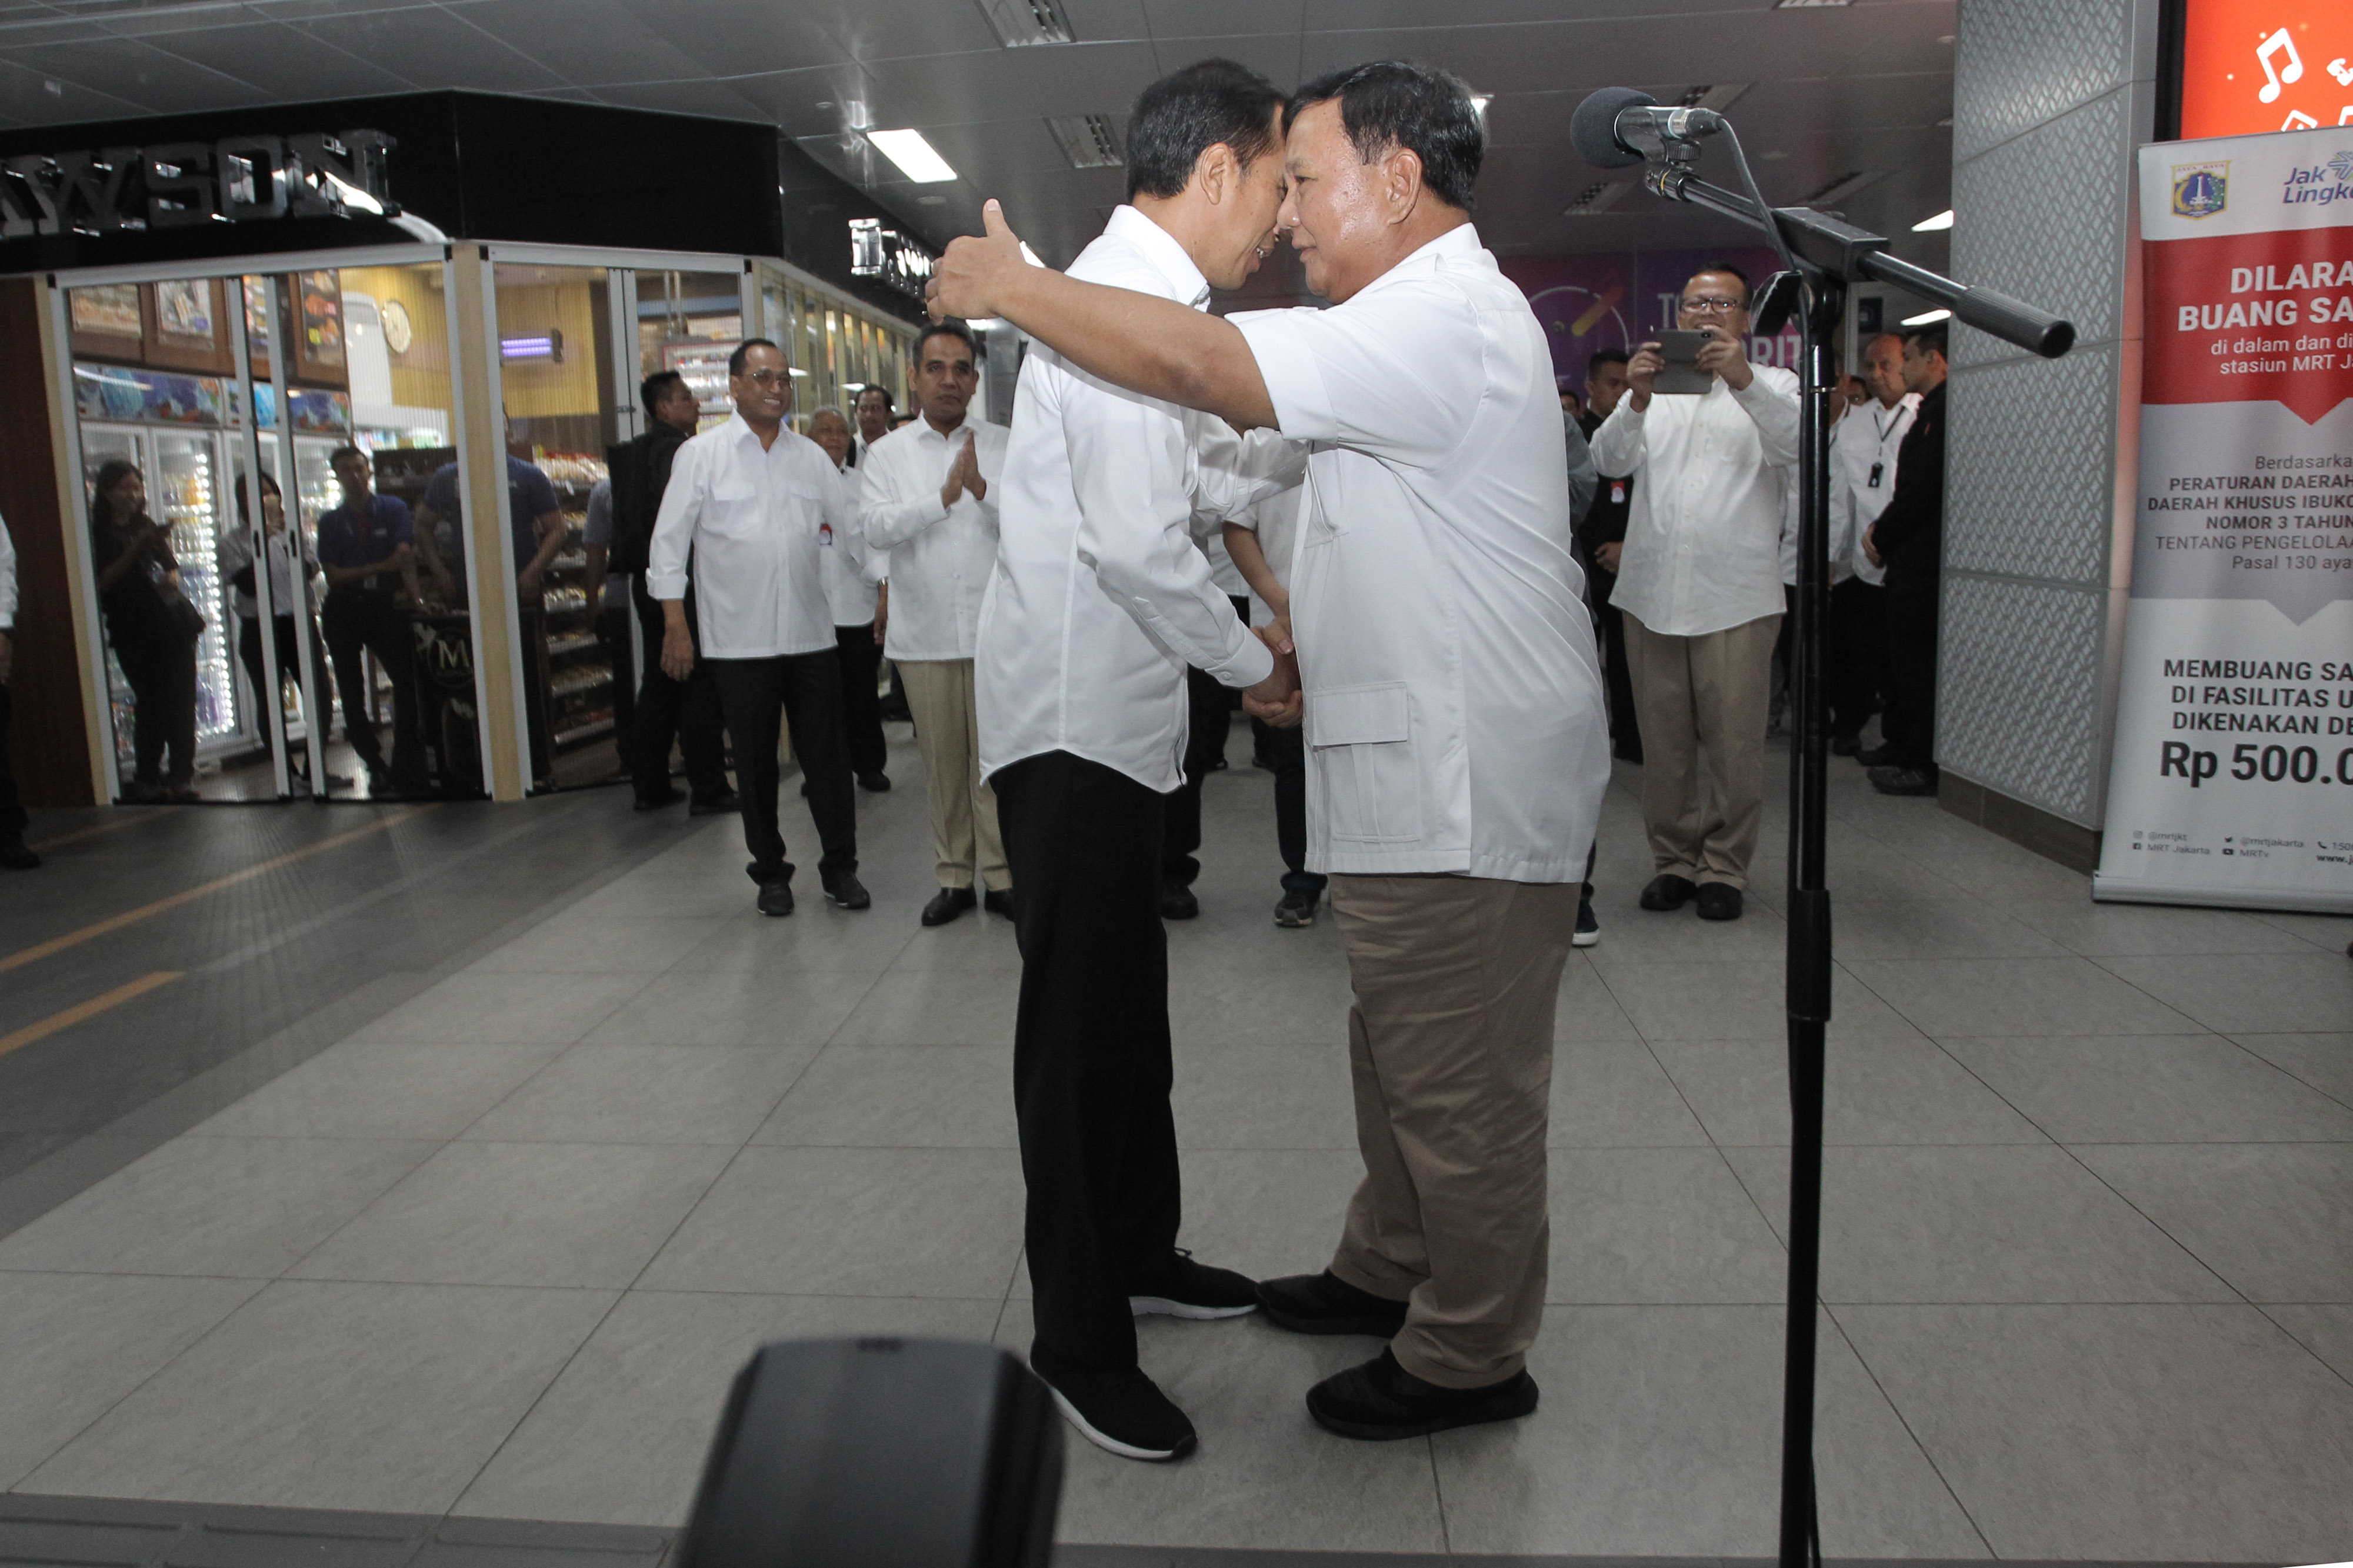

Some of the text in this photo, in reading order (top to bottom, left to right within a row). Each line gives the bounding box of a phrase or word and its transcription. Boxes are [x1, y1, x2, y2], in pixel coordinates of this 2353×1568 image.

[2283, 166, 2327, 185] Jak
[2282, 182, 2353, 206] Lingk
[2231, 261, 2353, 293] DILARA
[2178, 296, 2353, 332] BUANG SA
[2211, 332, 2353, 355] di dalam dan di
[2219, 353, 2353, 375] stasiun MRT J
[2255, 454, 2353, 470] Berdasarka
[2169, 474, 2353, 491] PERATURAN DAERAH
[2148, 498, 2218, 511] DAERAH
[2224, 496, 2296, 511] KHUSUS
[2206, 515, 2272, 529] NOMOR
[2278, 515, 2288, 529] 3
[2155, 536, 2235, 550] TENTANG
[2232, 556, 2353, 572] Pasal 130 aya
[2164, 659, 2353, 681] MEMBUANG SA
[2171, 685, 2353, 709] DI FASILITAS U
[2172, 711, 2318, 734] DIKENAKAN
[2160, 740, 2353, 788] Rp 500.0
[2147, 843, 2210, 855] MRT Jakarta
[2316, 854, 2353, 865] www.j
